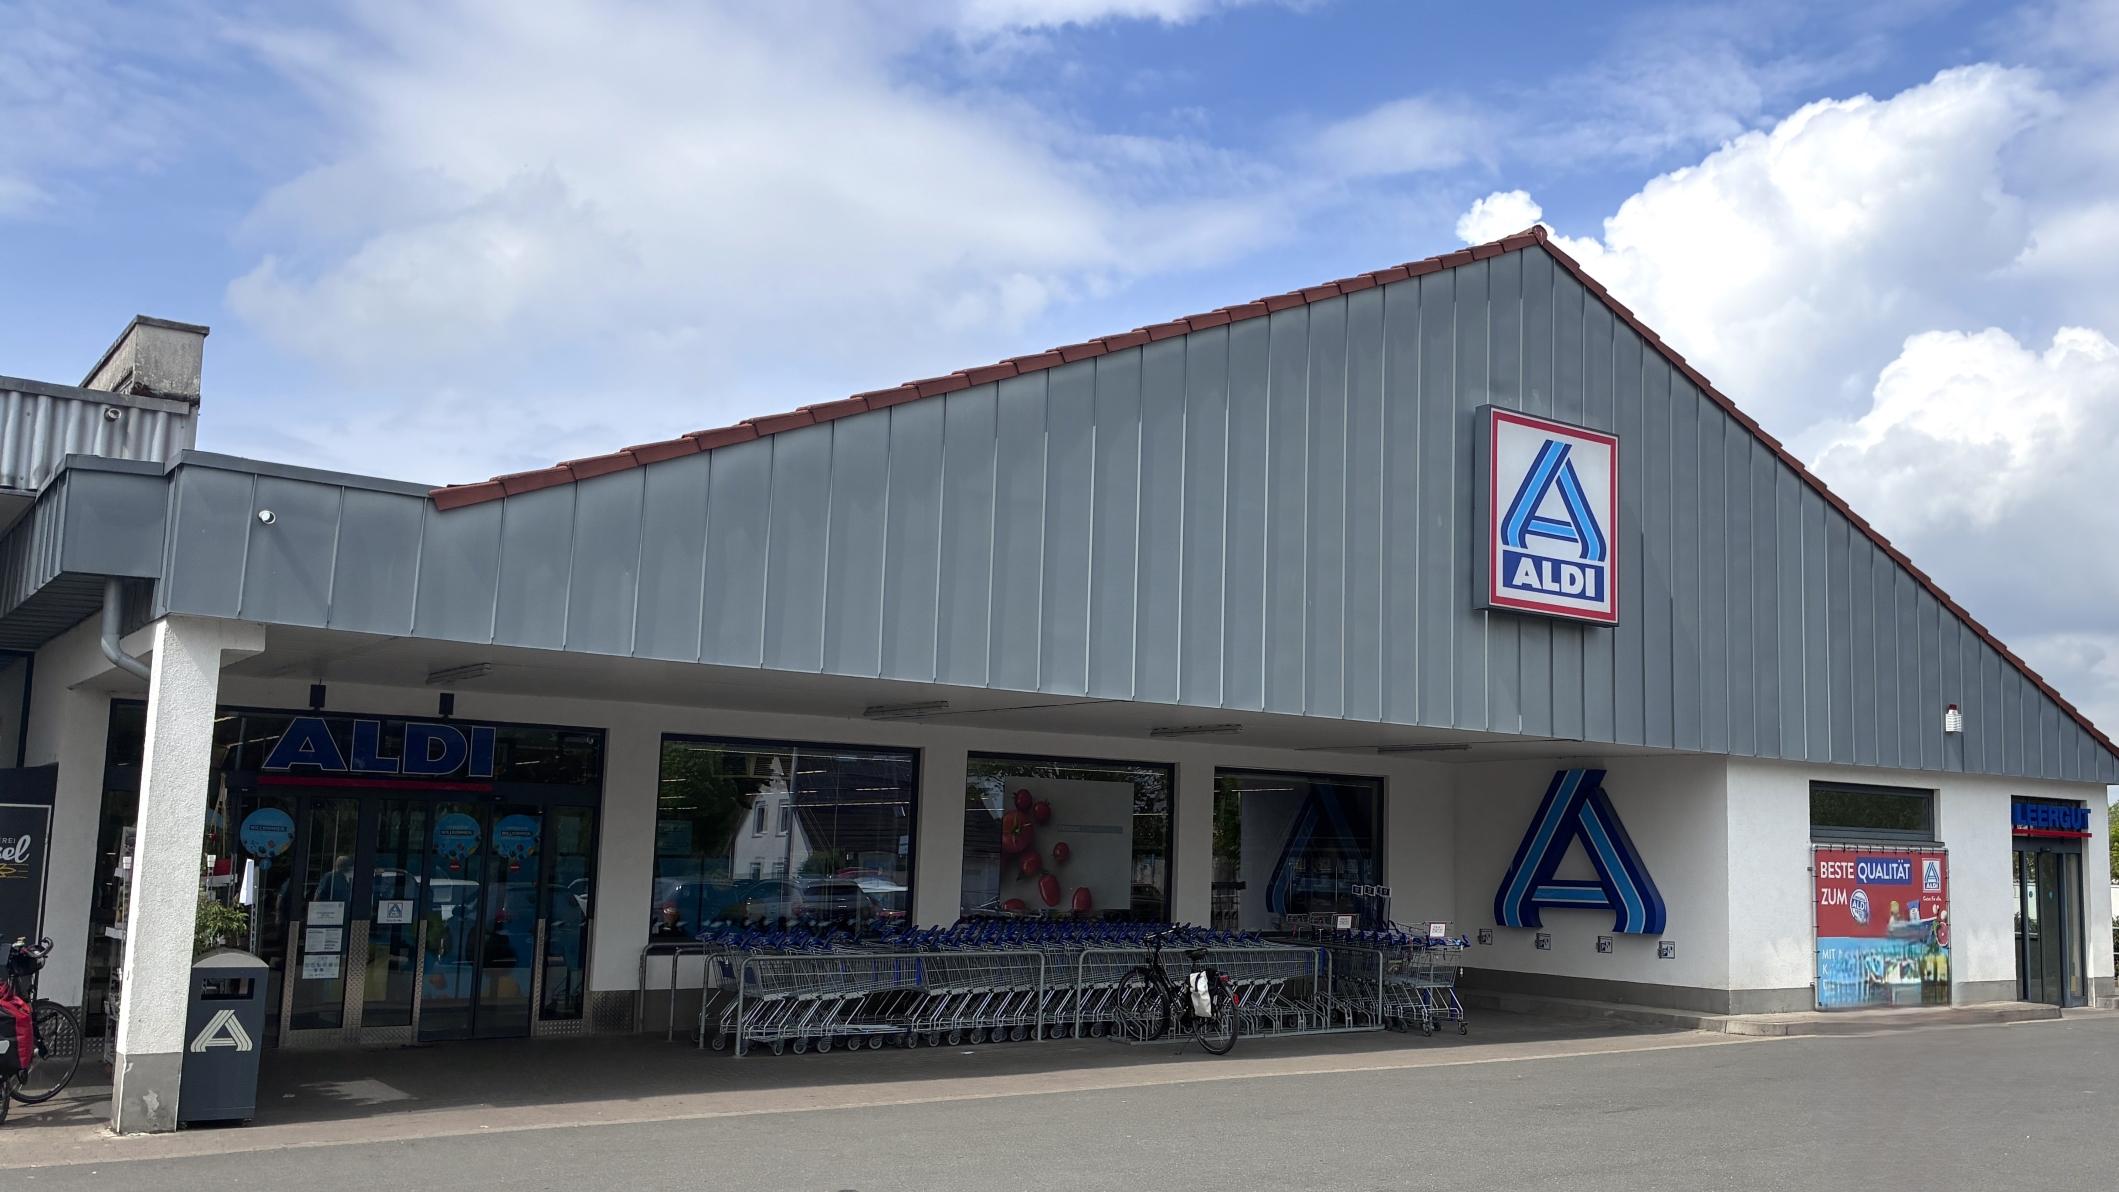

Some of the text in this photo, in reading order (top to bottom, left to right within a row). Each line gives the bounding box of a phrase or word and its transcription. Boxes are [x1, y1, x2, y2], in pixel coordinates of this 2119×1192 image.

[1512, 556, 1596, 598] ALDI
[261, 716, 497, 778] ALDI
[2013, 803, 2091, 830] LEERGUT
[1820, 859, 1911, 883] BESTE QUALITÄT
[1820, 887, 1848, 905] ZUM
[1925, 882, 1939, 890] ALDI
[1851, 899, 1867, 912] ALDI
[1822, 948, 1836, 960] MIT
